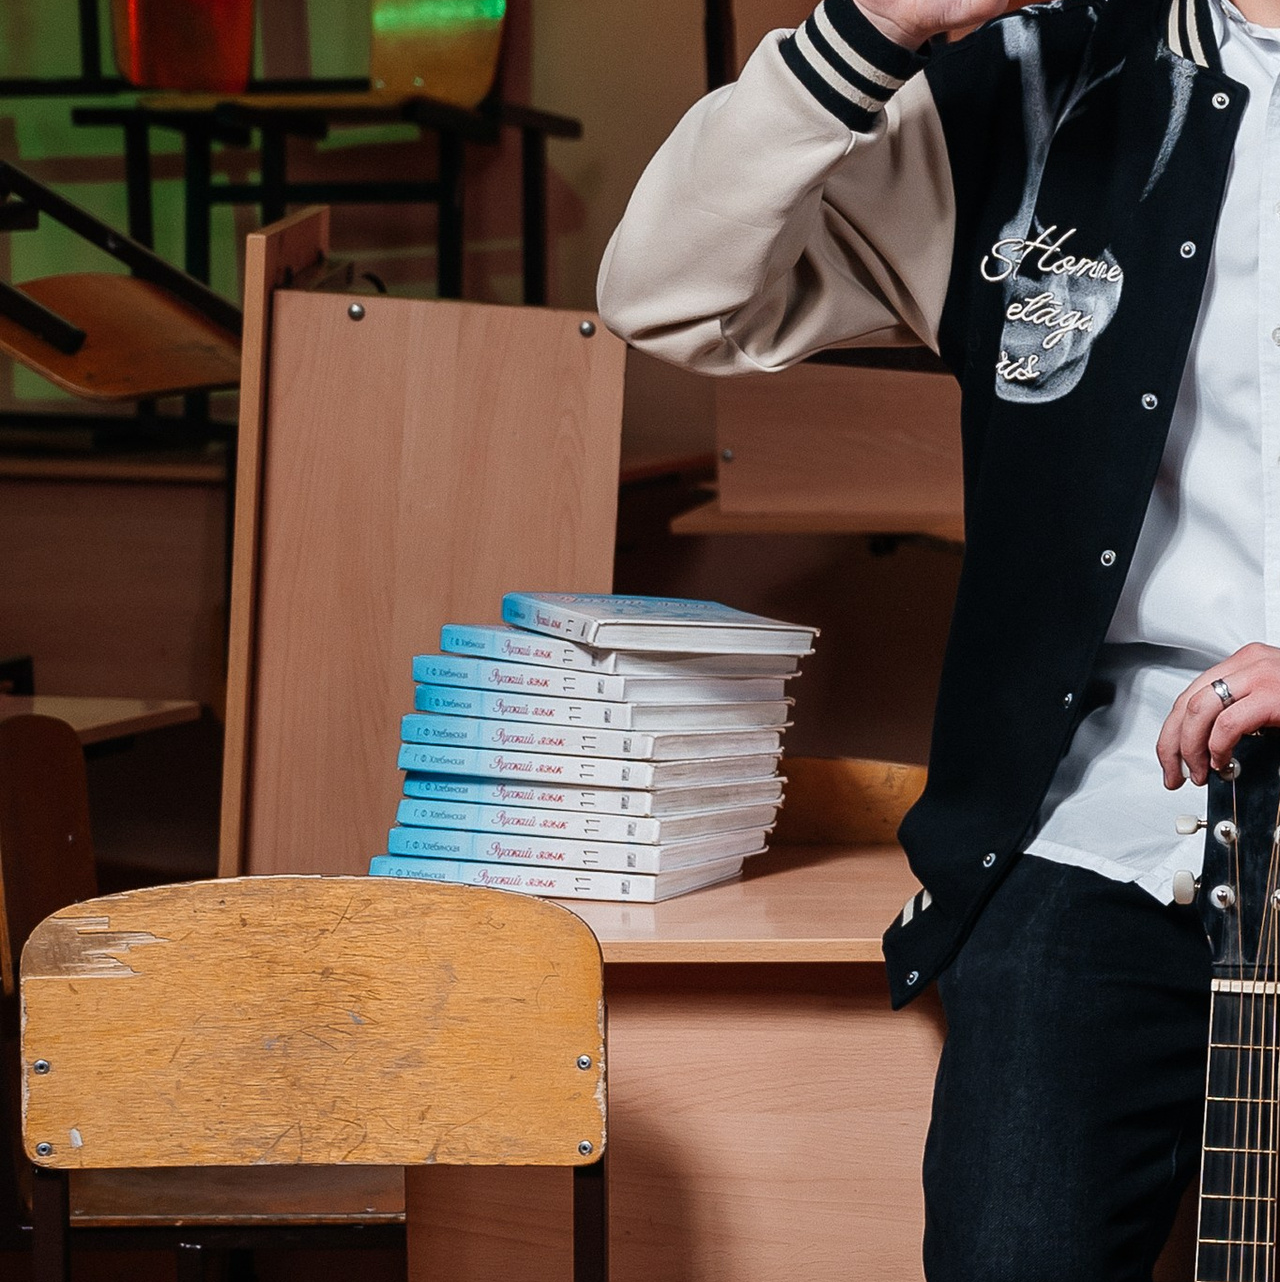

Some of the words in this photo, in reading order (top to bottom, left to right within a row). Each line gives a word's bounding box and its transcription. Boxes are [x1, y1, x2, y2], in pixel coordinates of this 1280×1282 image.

[501, 639, 531, 657] Русский
[533, 648, 552, 659] язык
[488, 669, 524, 686] Русский
[526, 678, 550, 687] язык
[492, 699, 530, 715] Русский
[532, 707, 556, 717] язык
[492, 727, 536, 747] Русский
[538, 737, 566, 747] язык
[489, 755, 532, 775] Русский
[535, 765, 564, 775] язык
[492, 783, 534, 803] Русский
[538, 793, 564, 803] язык
[491, 811, 536, 831] Русский
[538, 819, 568, 830] язык
[486, 841, 532, 859] Русский
[536, 850, 565, 861] язык
[474, 869, 522, 889] Русский
[526, 879, 556, 888] язык
